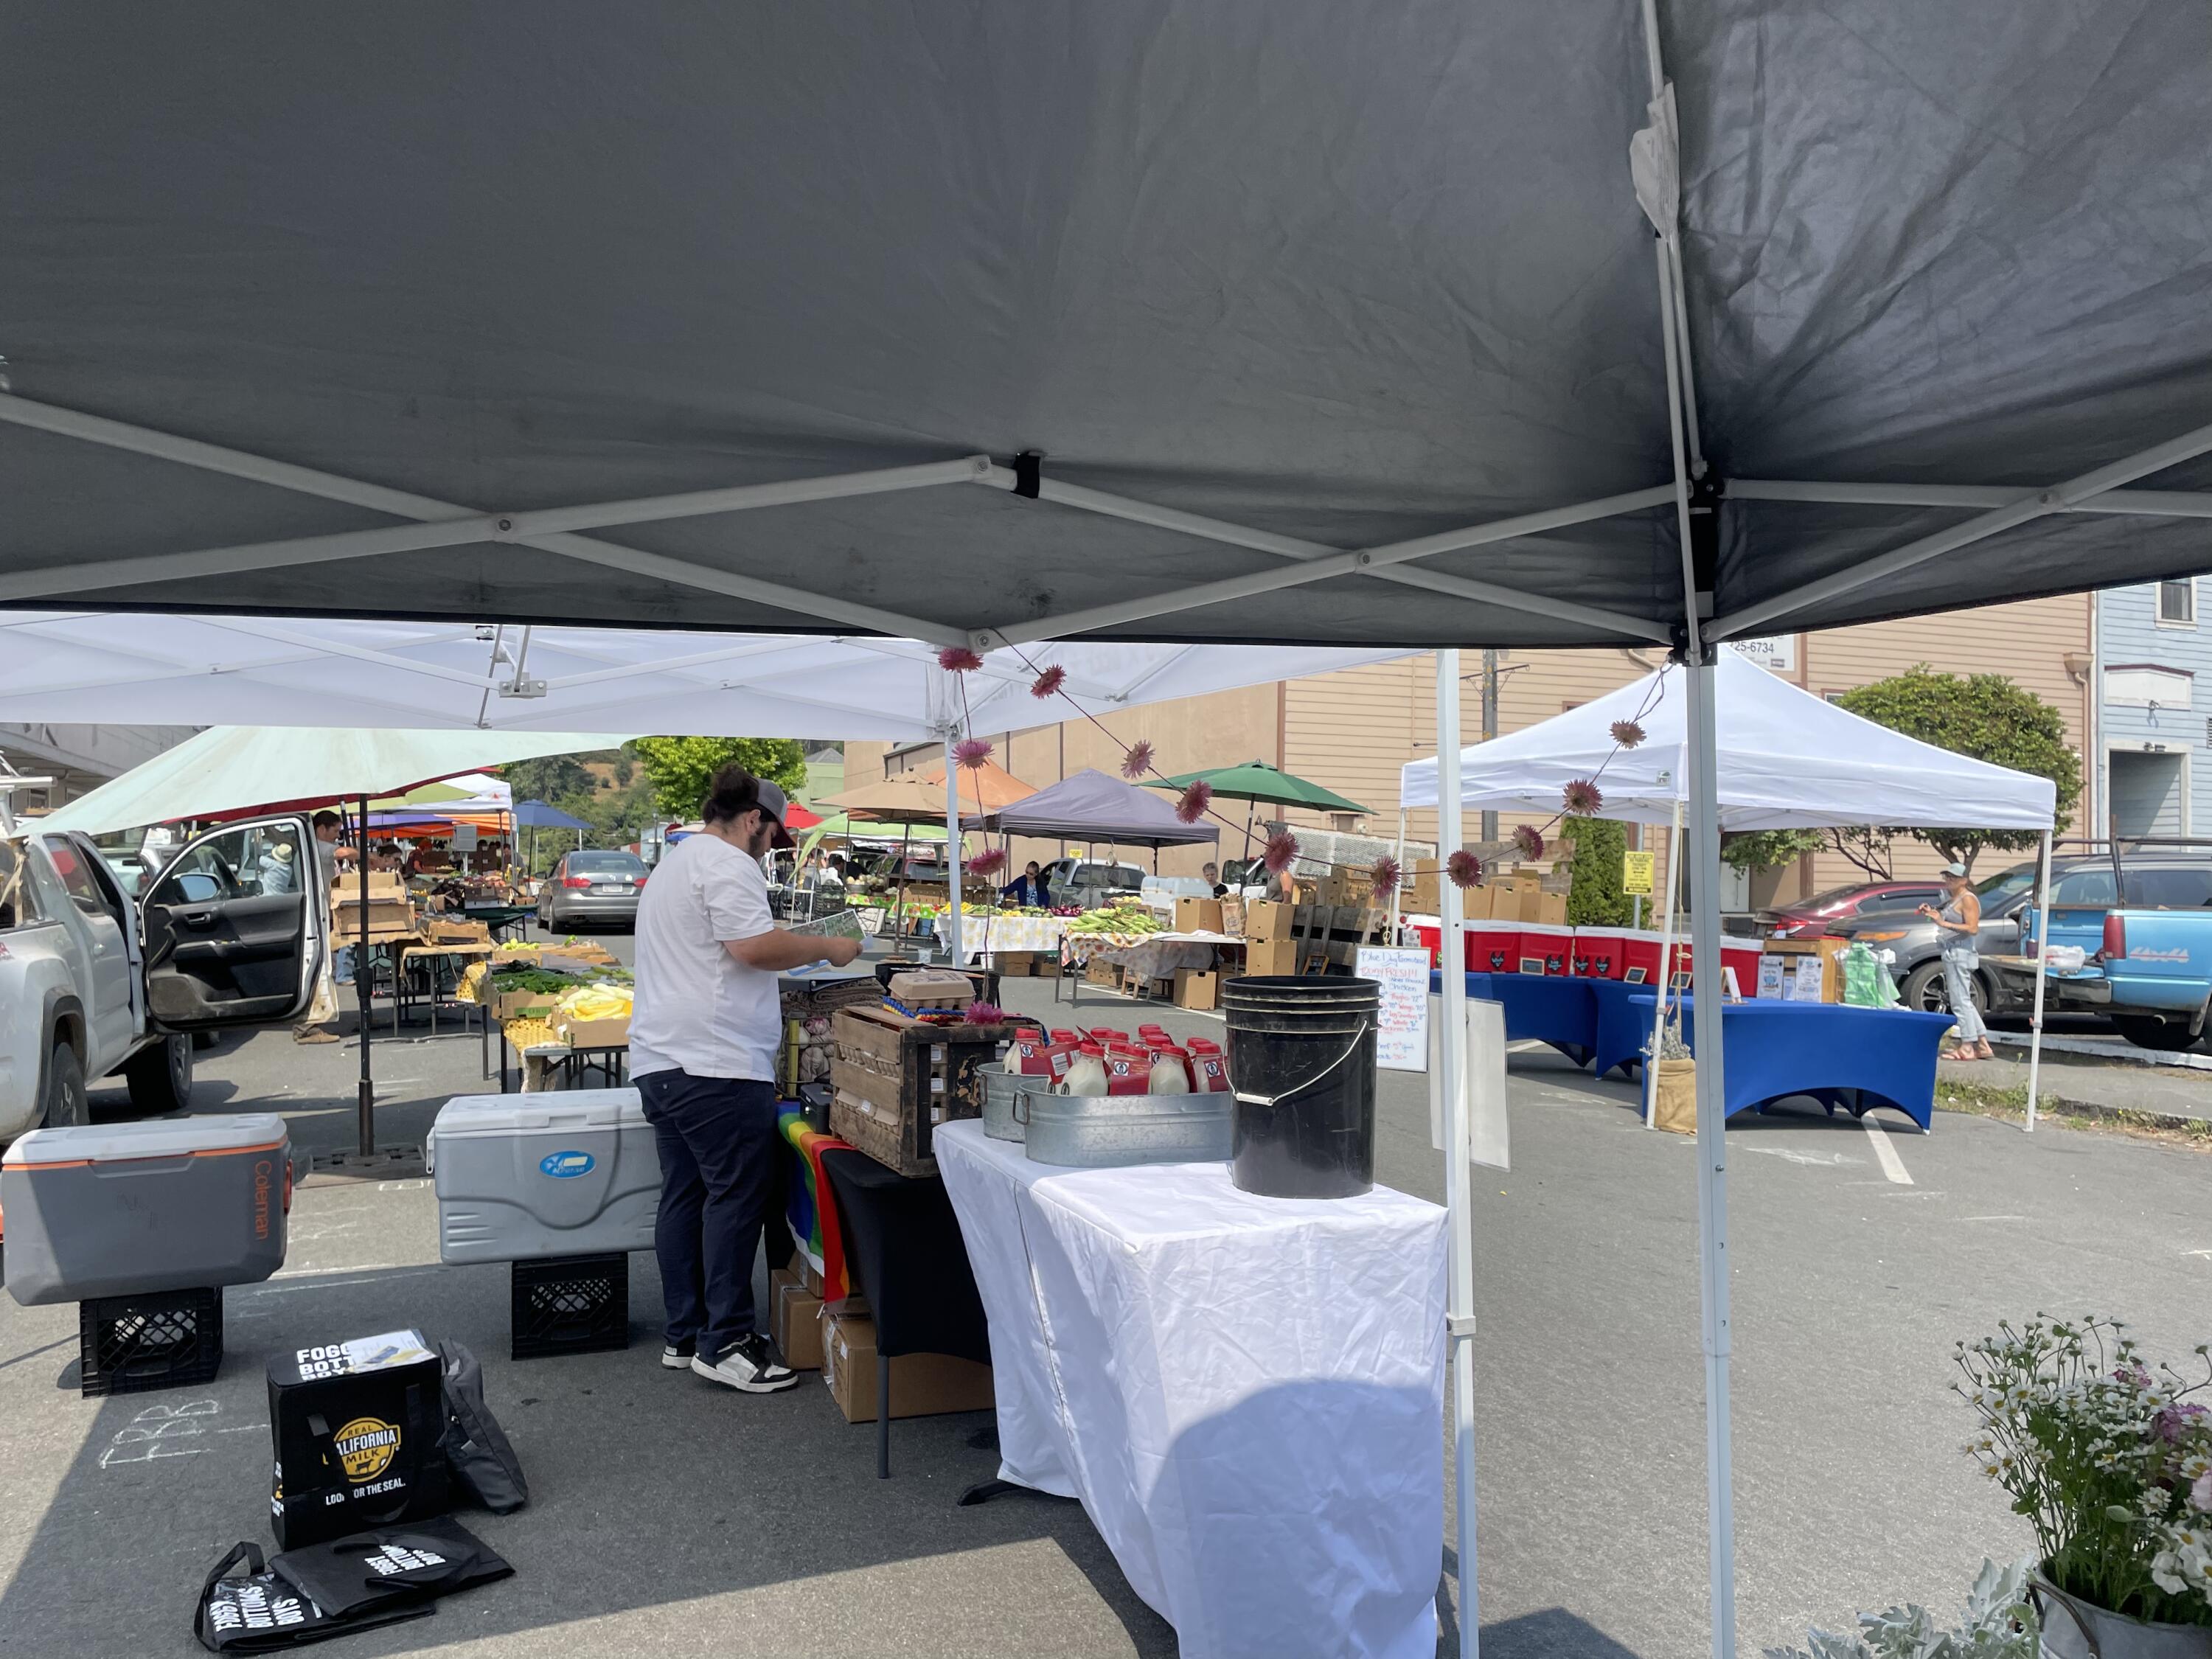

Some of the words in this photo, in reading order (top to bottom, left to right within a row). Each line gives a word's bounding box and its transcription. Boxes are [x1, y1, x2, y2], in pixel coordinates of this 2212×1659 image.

[255, 1161, 272, 1240] Coleman
[299, 1356, 355, 1376] BOTT
[301, 1368, 345, 1381] BOY
[336, 1429, 397, 1456] ALIFORNIA
[347, 1425, 374, 1436] REAL
[346, 1448, 380, 1465] MILK
[326, 1492, 344, 1506] LOO
[352, 1486, 365, 1498] OR
[366, 1482, 382, 1495] THE
[383, 1477, 406, 1492] SEAL.
[379, 1545, 425, 1571] BOTTOM
[209, 1601, 243, 1632] FOGGY
[237, 1586, 274, 1628] BOTTOMS
[271, 1598, 305, 1625] BOYS
